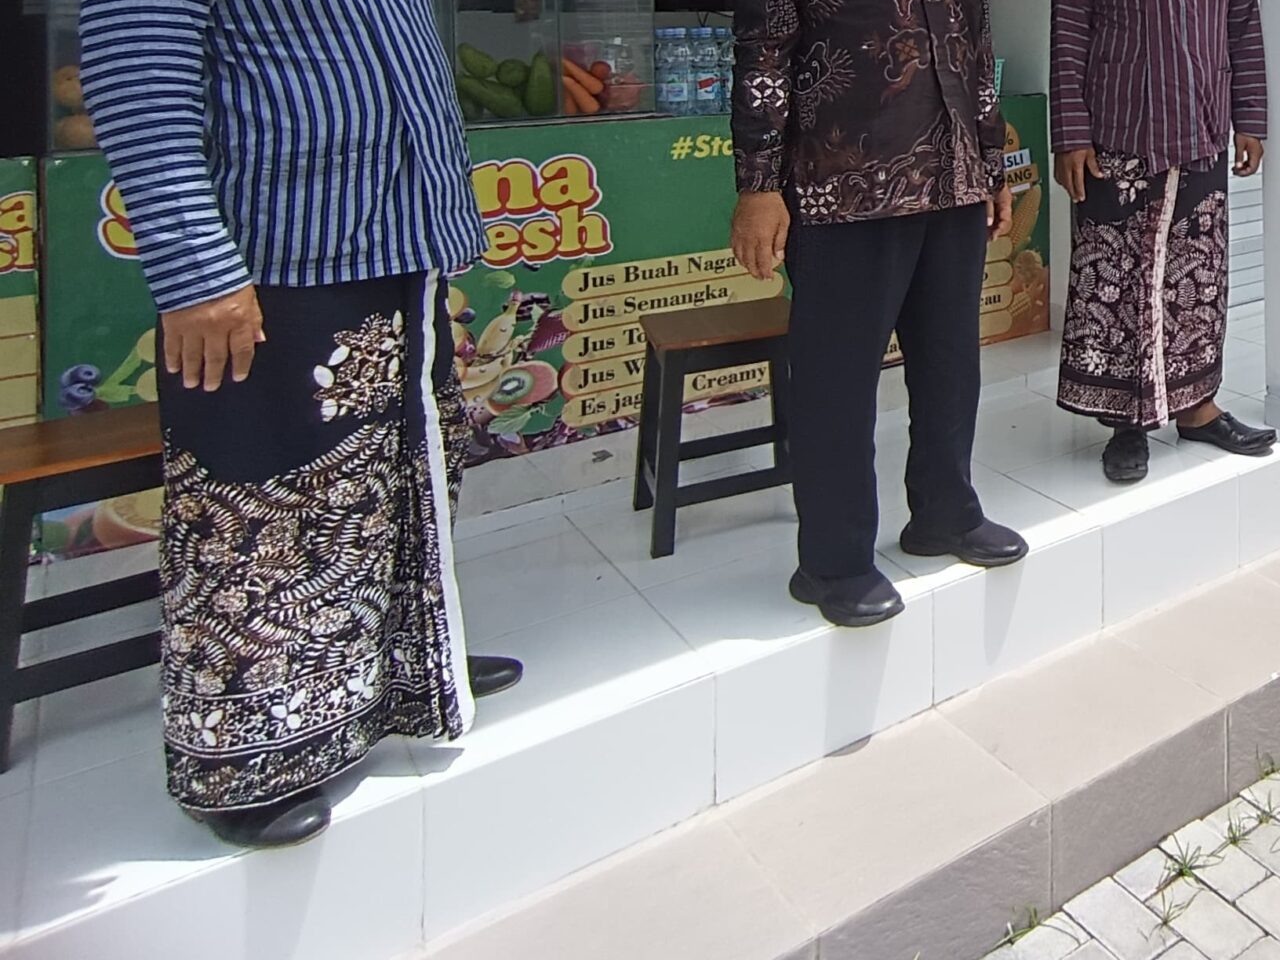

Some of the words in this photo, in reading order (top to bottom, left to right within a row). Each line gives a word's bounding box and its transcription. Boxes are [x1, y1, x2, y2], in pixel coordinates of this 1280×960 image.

[482, 205, 613, 268] esh
[578, 271, 616, 293] Jus
[623, 259, 679, 284] Buah
[687, 254, 737, 276] Naga
[578, 303, 616, 324] Jus
[623, 284, 729, 314] Semangka
[578, 336, 616, 357] Jus
[578, 368, 616, 389] Jus
[580, 397, 607, 417] Es
[691, 365, 767, 391] Creamy
